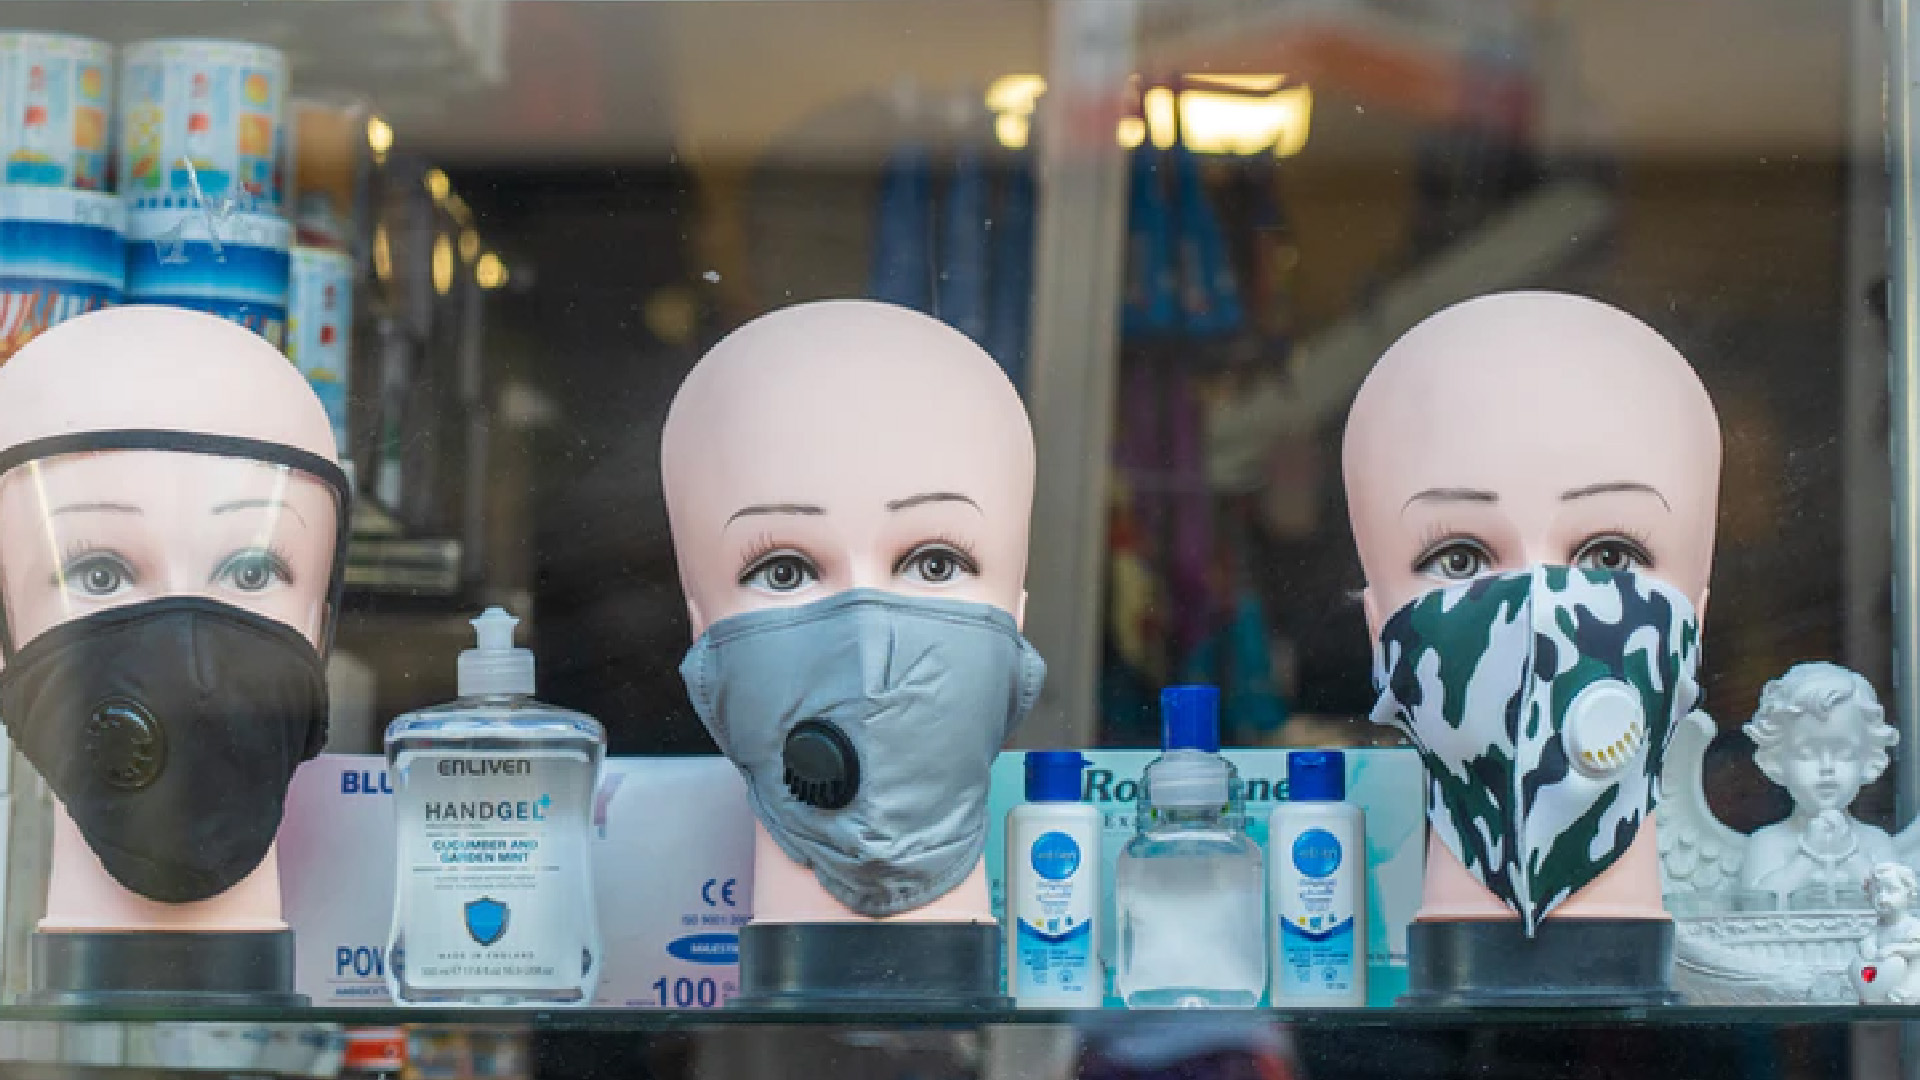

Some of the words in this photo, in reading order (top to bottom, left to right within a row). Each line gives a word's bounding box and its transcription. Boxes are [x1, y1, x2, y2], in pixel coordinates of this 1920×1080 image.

[425, 801, 547, 821] HANDGEL
[432, 839, 507, 851] CUCUMBER
[511, 839, 538, 851] AND
[702, 878, 737, 907] CE
[653, 976, 717, 1008] 100
